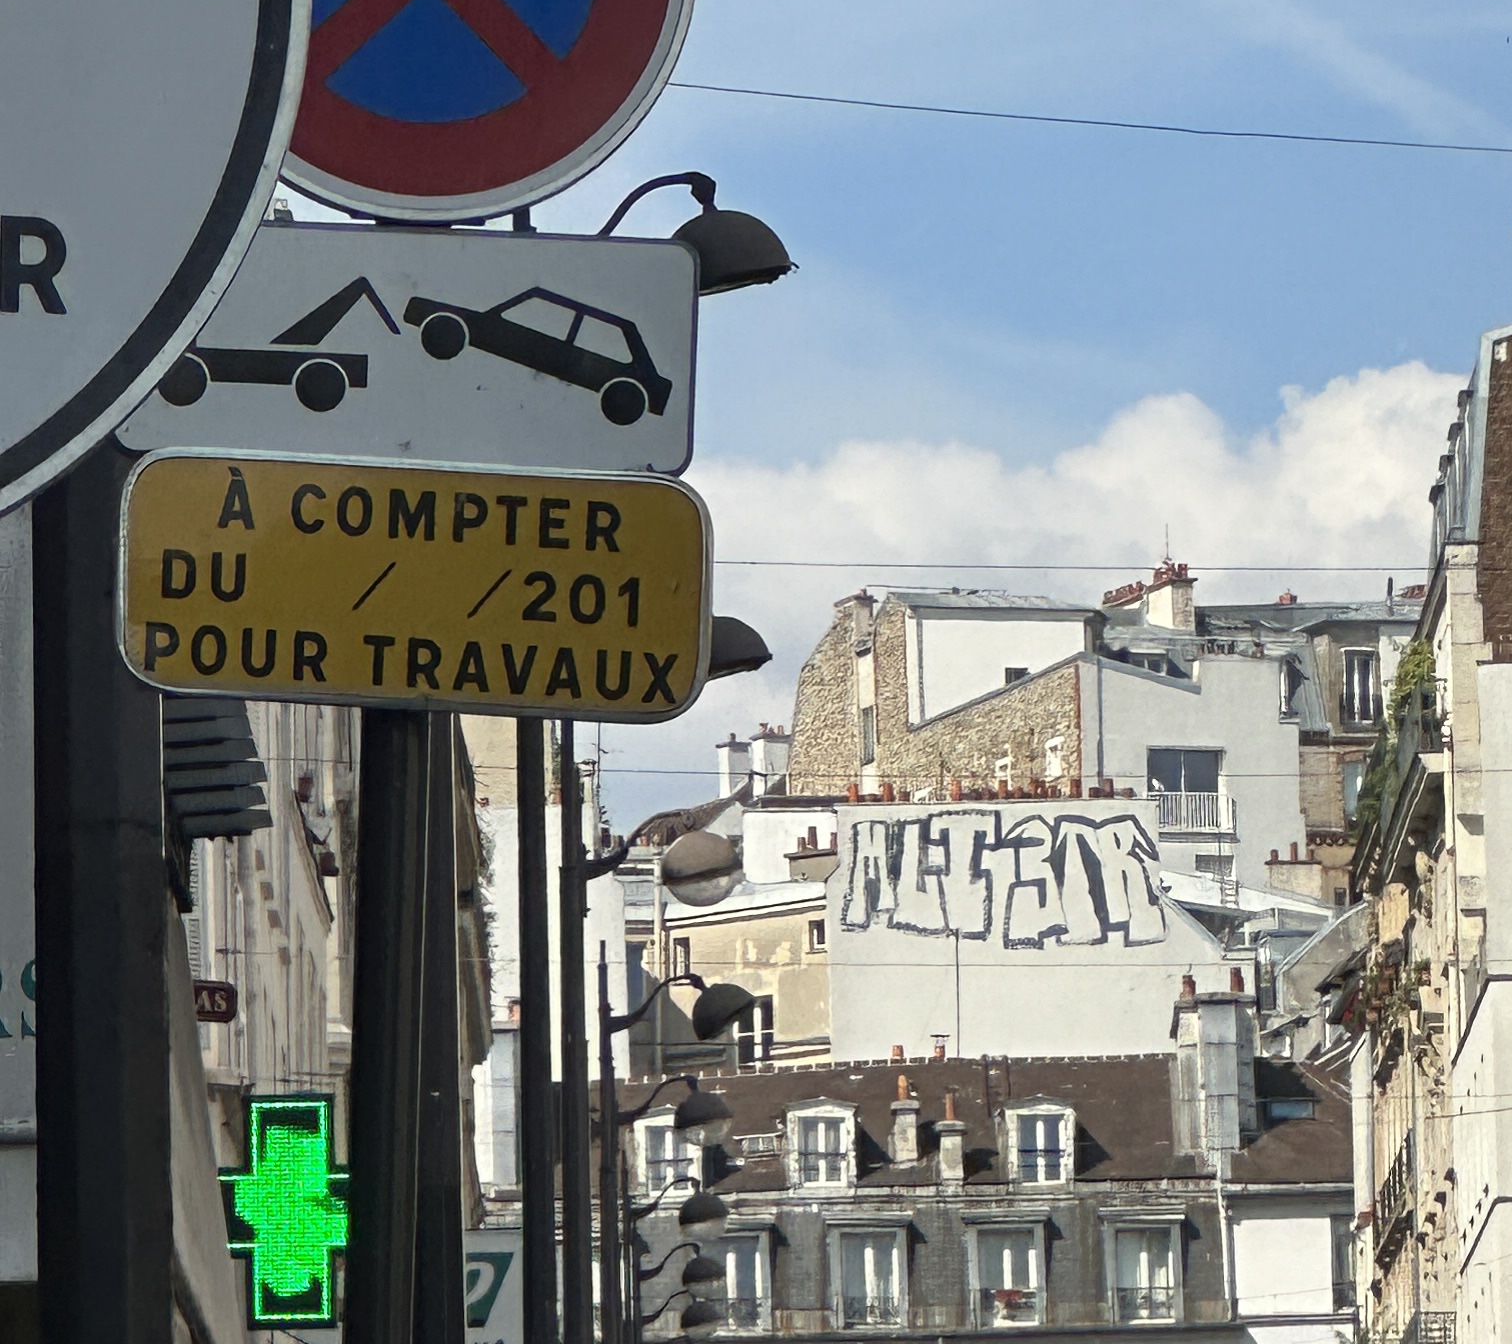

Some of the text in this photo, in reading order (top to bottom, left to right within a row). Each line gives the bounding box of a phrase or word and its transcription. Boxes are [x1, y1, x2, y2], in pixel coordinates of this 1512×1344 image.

[0, 214, 68, 315] R
[216, 466, 622, 553] À COMPTER
[160, 548, 247, 603] DU
[144, 621, 680, 705] POUR TRAVAUX
